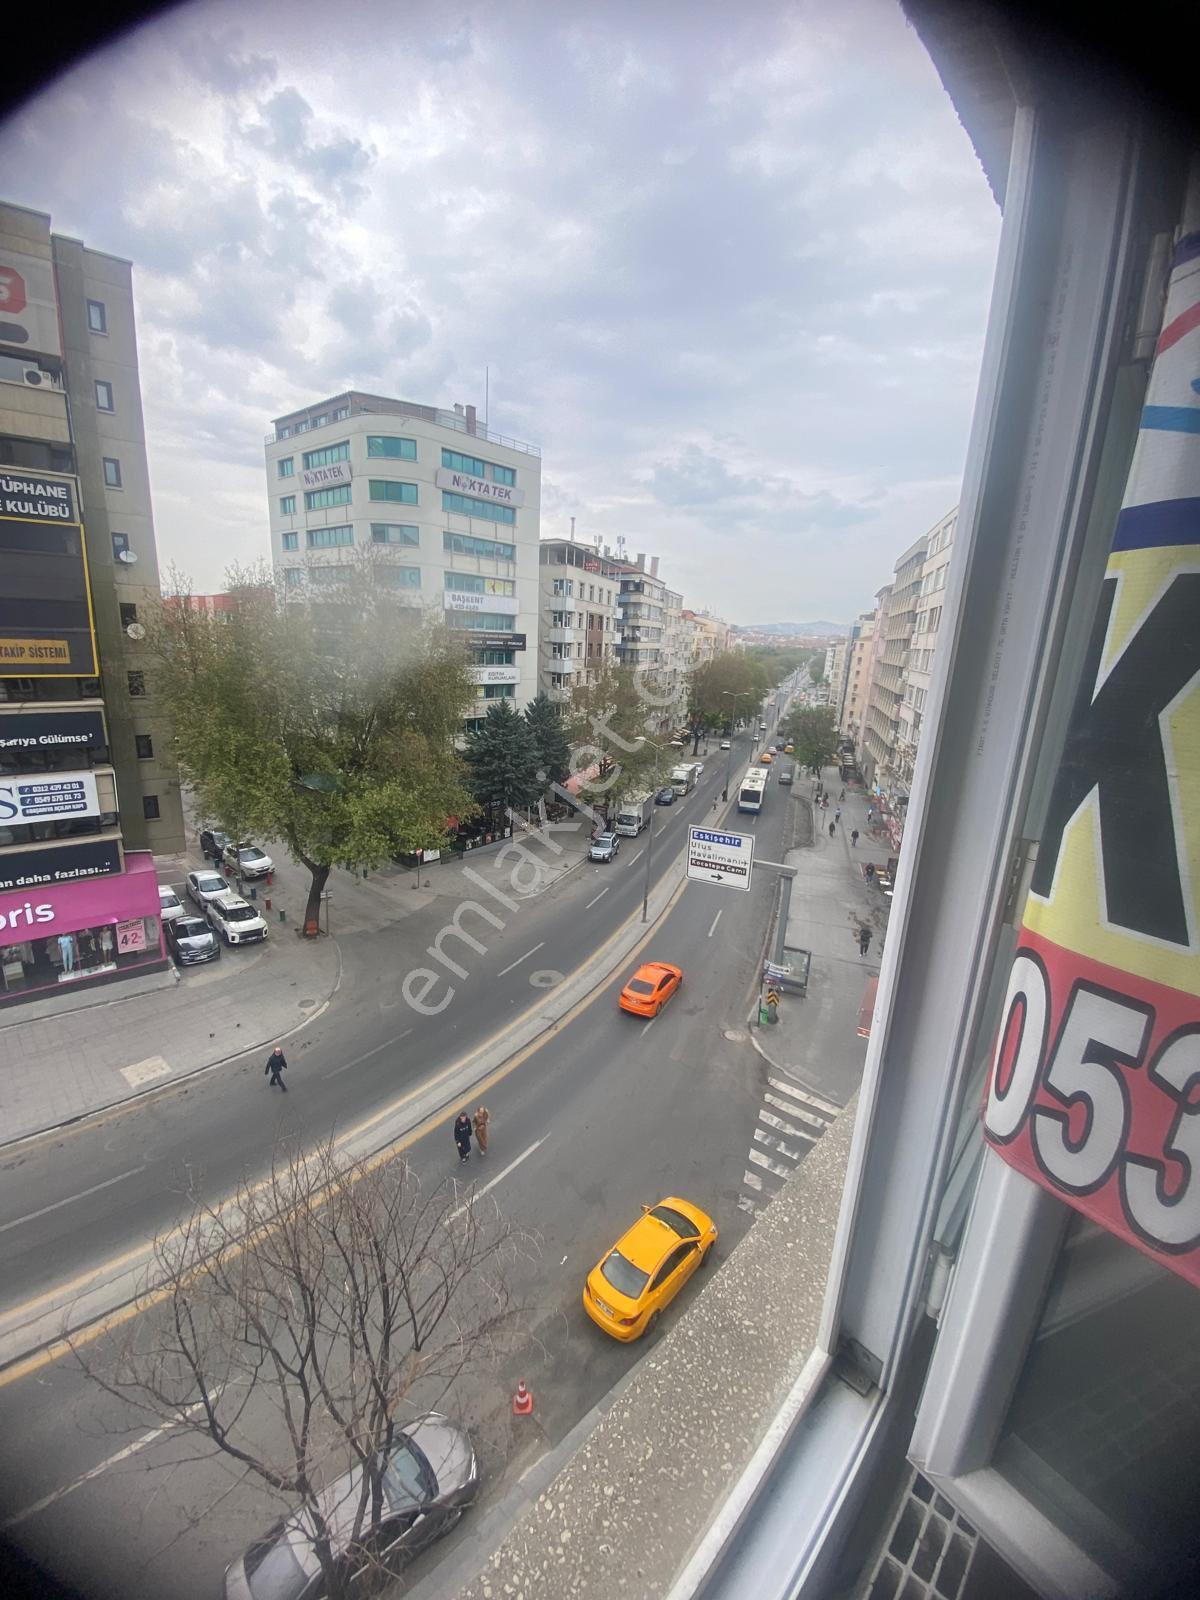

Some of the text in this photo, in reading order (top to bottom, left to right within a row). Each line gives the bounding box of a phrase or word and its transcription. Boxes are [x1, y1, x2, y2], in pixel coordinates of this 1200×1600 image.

[5, 500, 70, 518] KULÜBÜ
[691, 841, 712, 850] Ulus
[692, 859, 725, 870] Kocatepe
[16, 874, 51, 886] daha
[975, 947, 1200, 1256] 053
